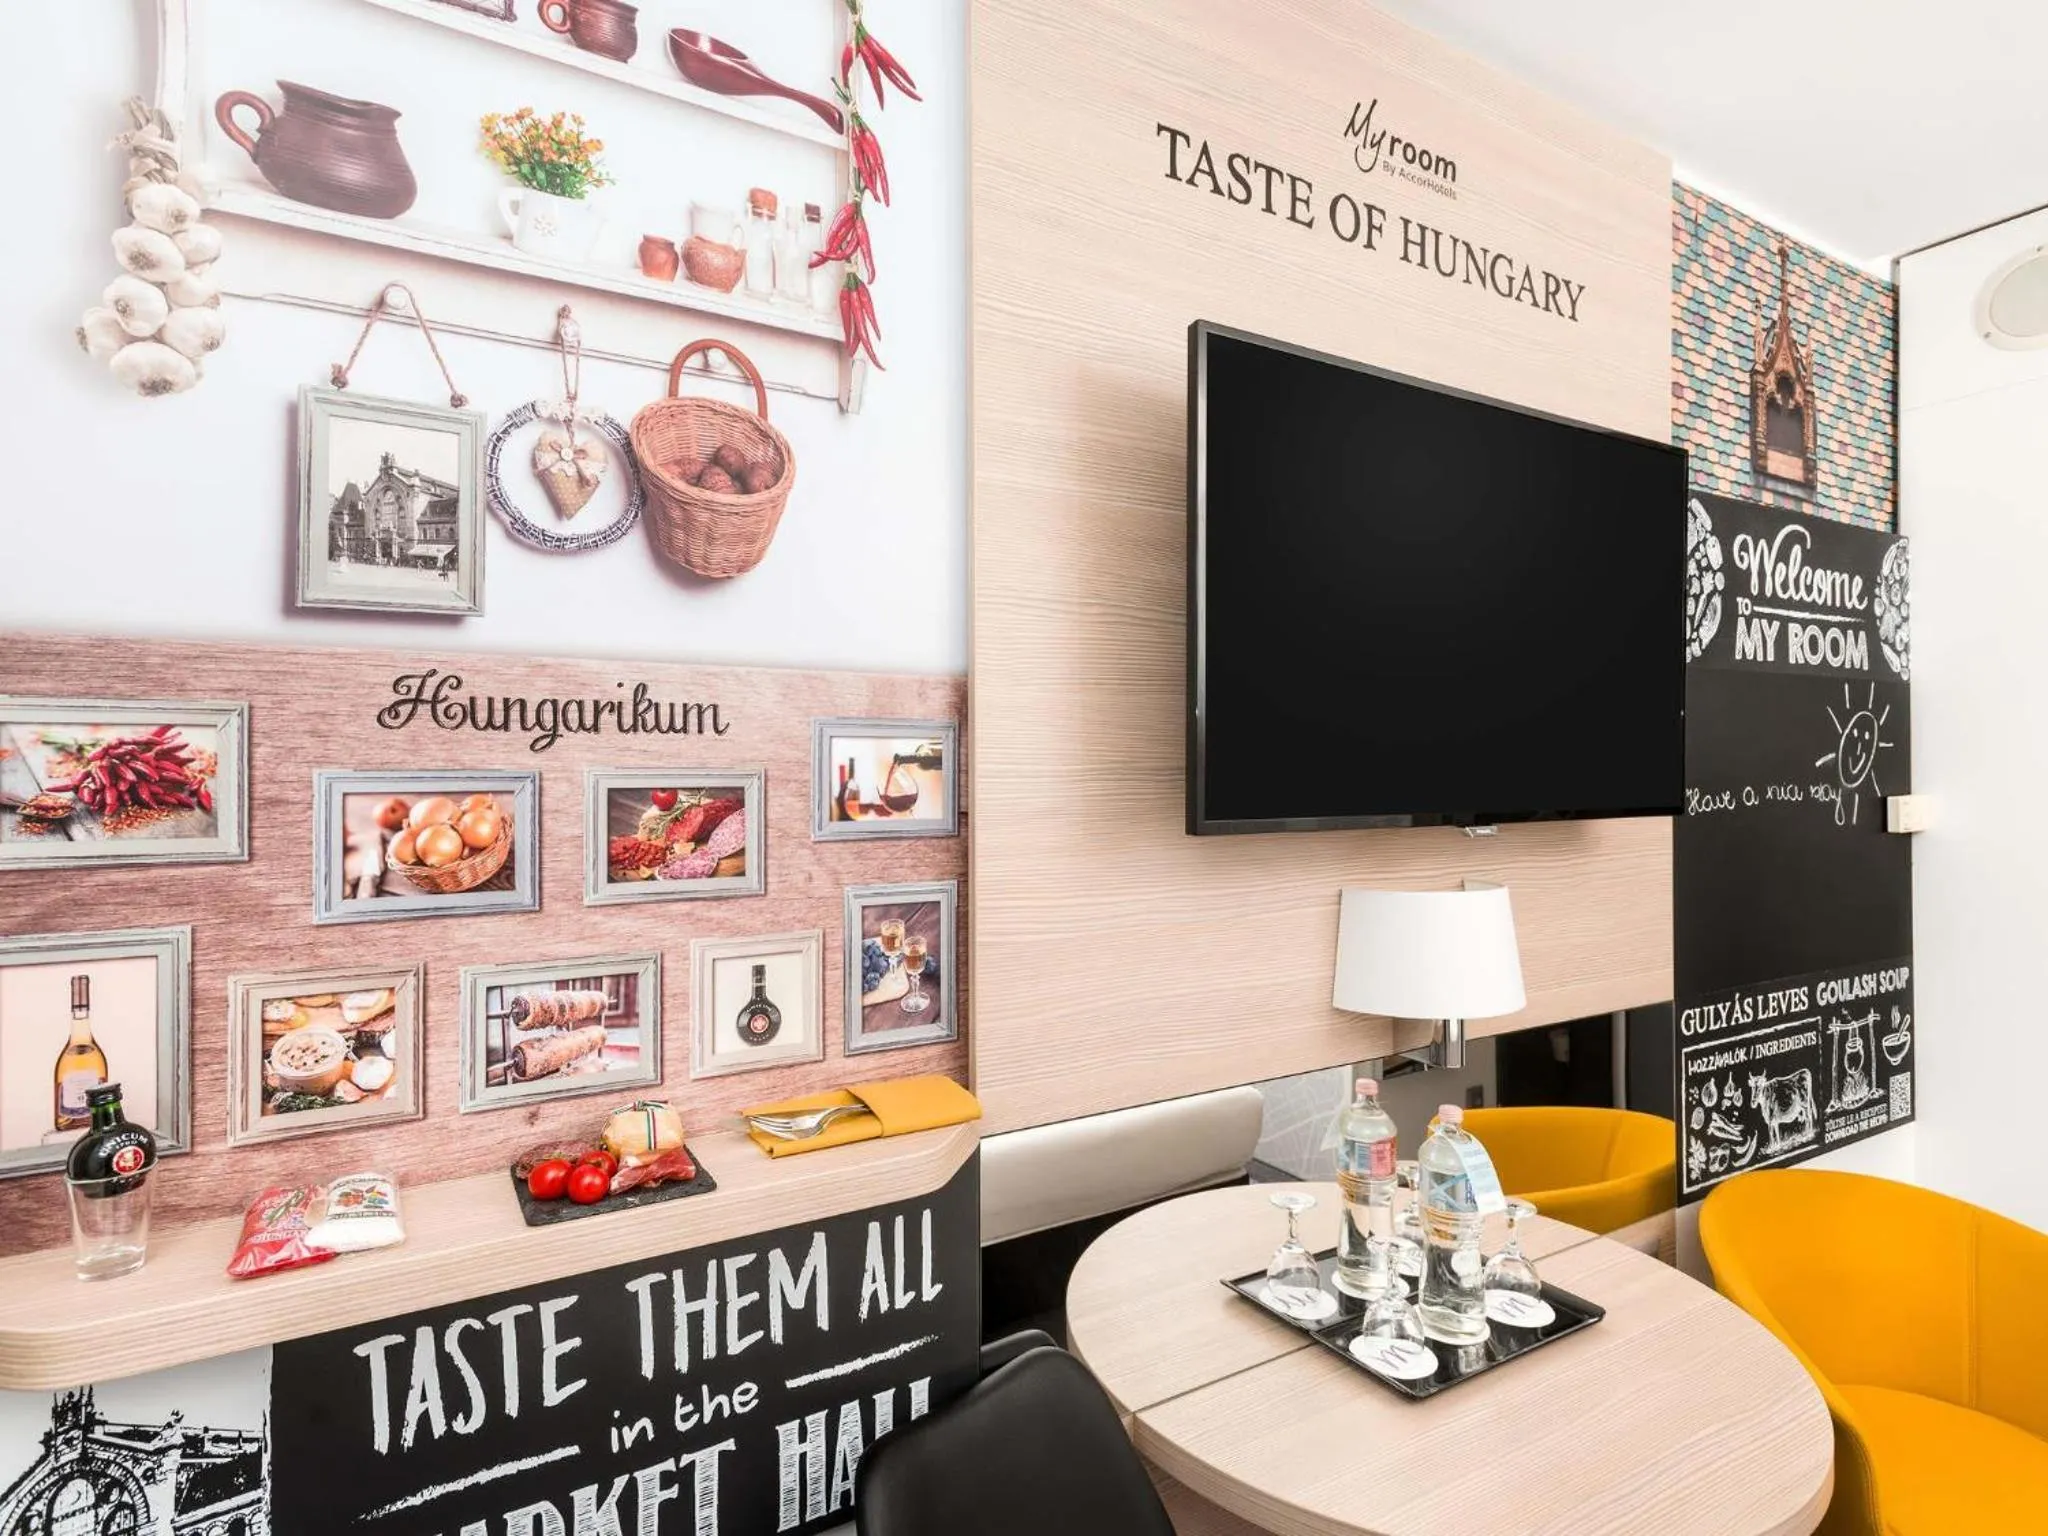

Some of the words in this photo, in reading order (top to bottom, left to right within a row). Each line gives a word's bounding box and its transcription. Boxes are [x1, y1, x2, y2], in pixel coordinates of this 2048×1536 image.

[1382, 159, 1397, 177] By
[1400, 167, 1458, 201] AccorHotels
[1156, 121, 1316, 230] TASTE
[1329, 192, 1388, 251] OF
[1398, 215, 1587, 323] HUNGARY
[1732, 524, 1869, 611] Welcome
[1736, 596, 1752, 616] TO
[1734, 616, 1781, 663] MY
[1787, 621, 1869, 671] ROOM
[375, 667, 731, 752] Hungarikum
[1685, 787, 1736, 816] Have
[1680, 992, 1754, 1037] GULYÁS
[1756, 985, 1810, 1020] LEVES
[1815, 972, 1878, 1007] GOULASH
[1879, 966, 1911, 994] SOUP
[1755, 1030, 1818, 1060] INGREDIENTS
[98, 1131, 149, 1159] UNICUM
[352, 1295, 588, 1455] TASTE
[625, 1231, 830, 1380] THEM
[859, 1209, 943, 1323] ALL
[610, 1409, 656, 1453] in
[674, 1380, 759, 1431] the
